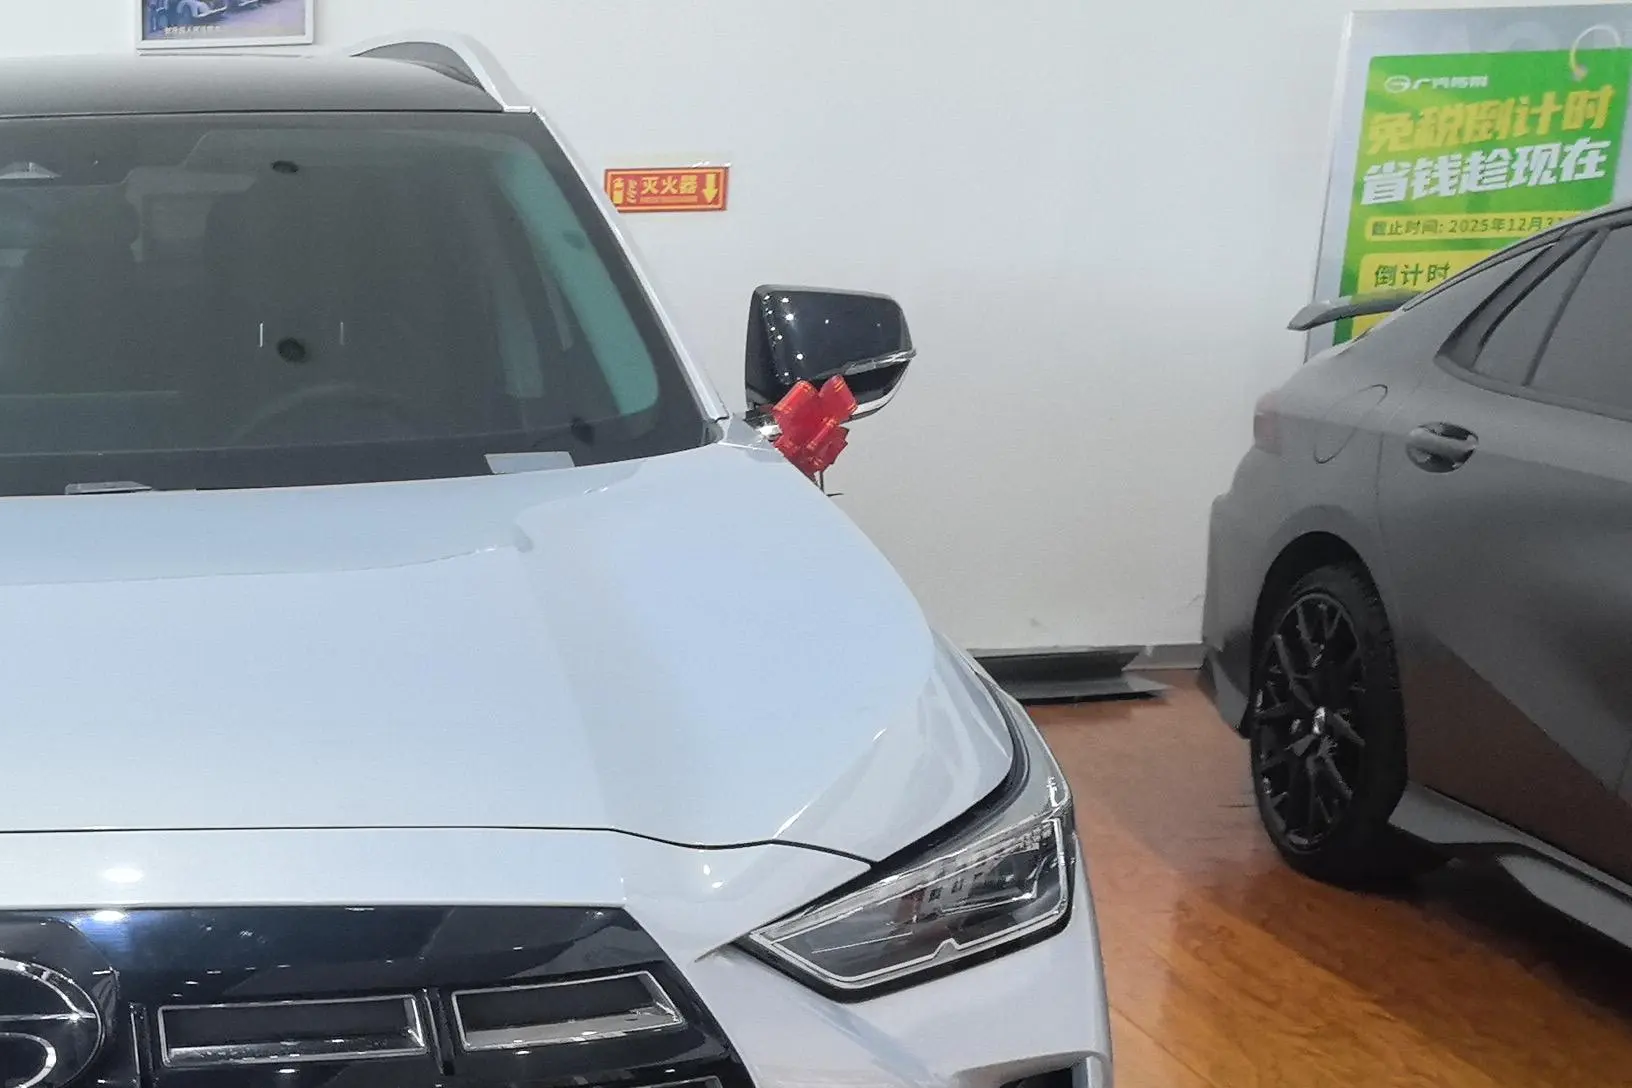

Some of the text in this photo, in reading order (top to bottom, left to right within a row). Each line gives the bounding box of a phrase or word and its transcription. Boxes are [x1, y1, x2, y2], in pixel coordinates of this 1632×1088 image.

[1368, 84, 1615, 155] 免税倒计时
[640, 174, 697, 195] 灭火器
[1360, 137, 1612, 205] 省钱趁现在
[1374, 261, 1452, 287] 倒计时
